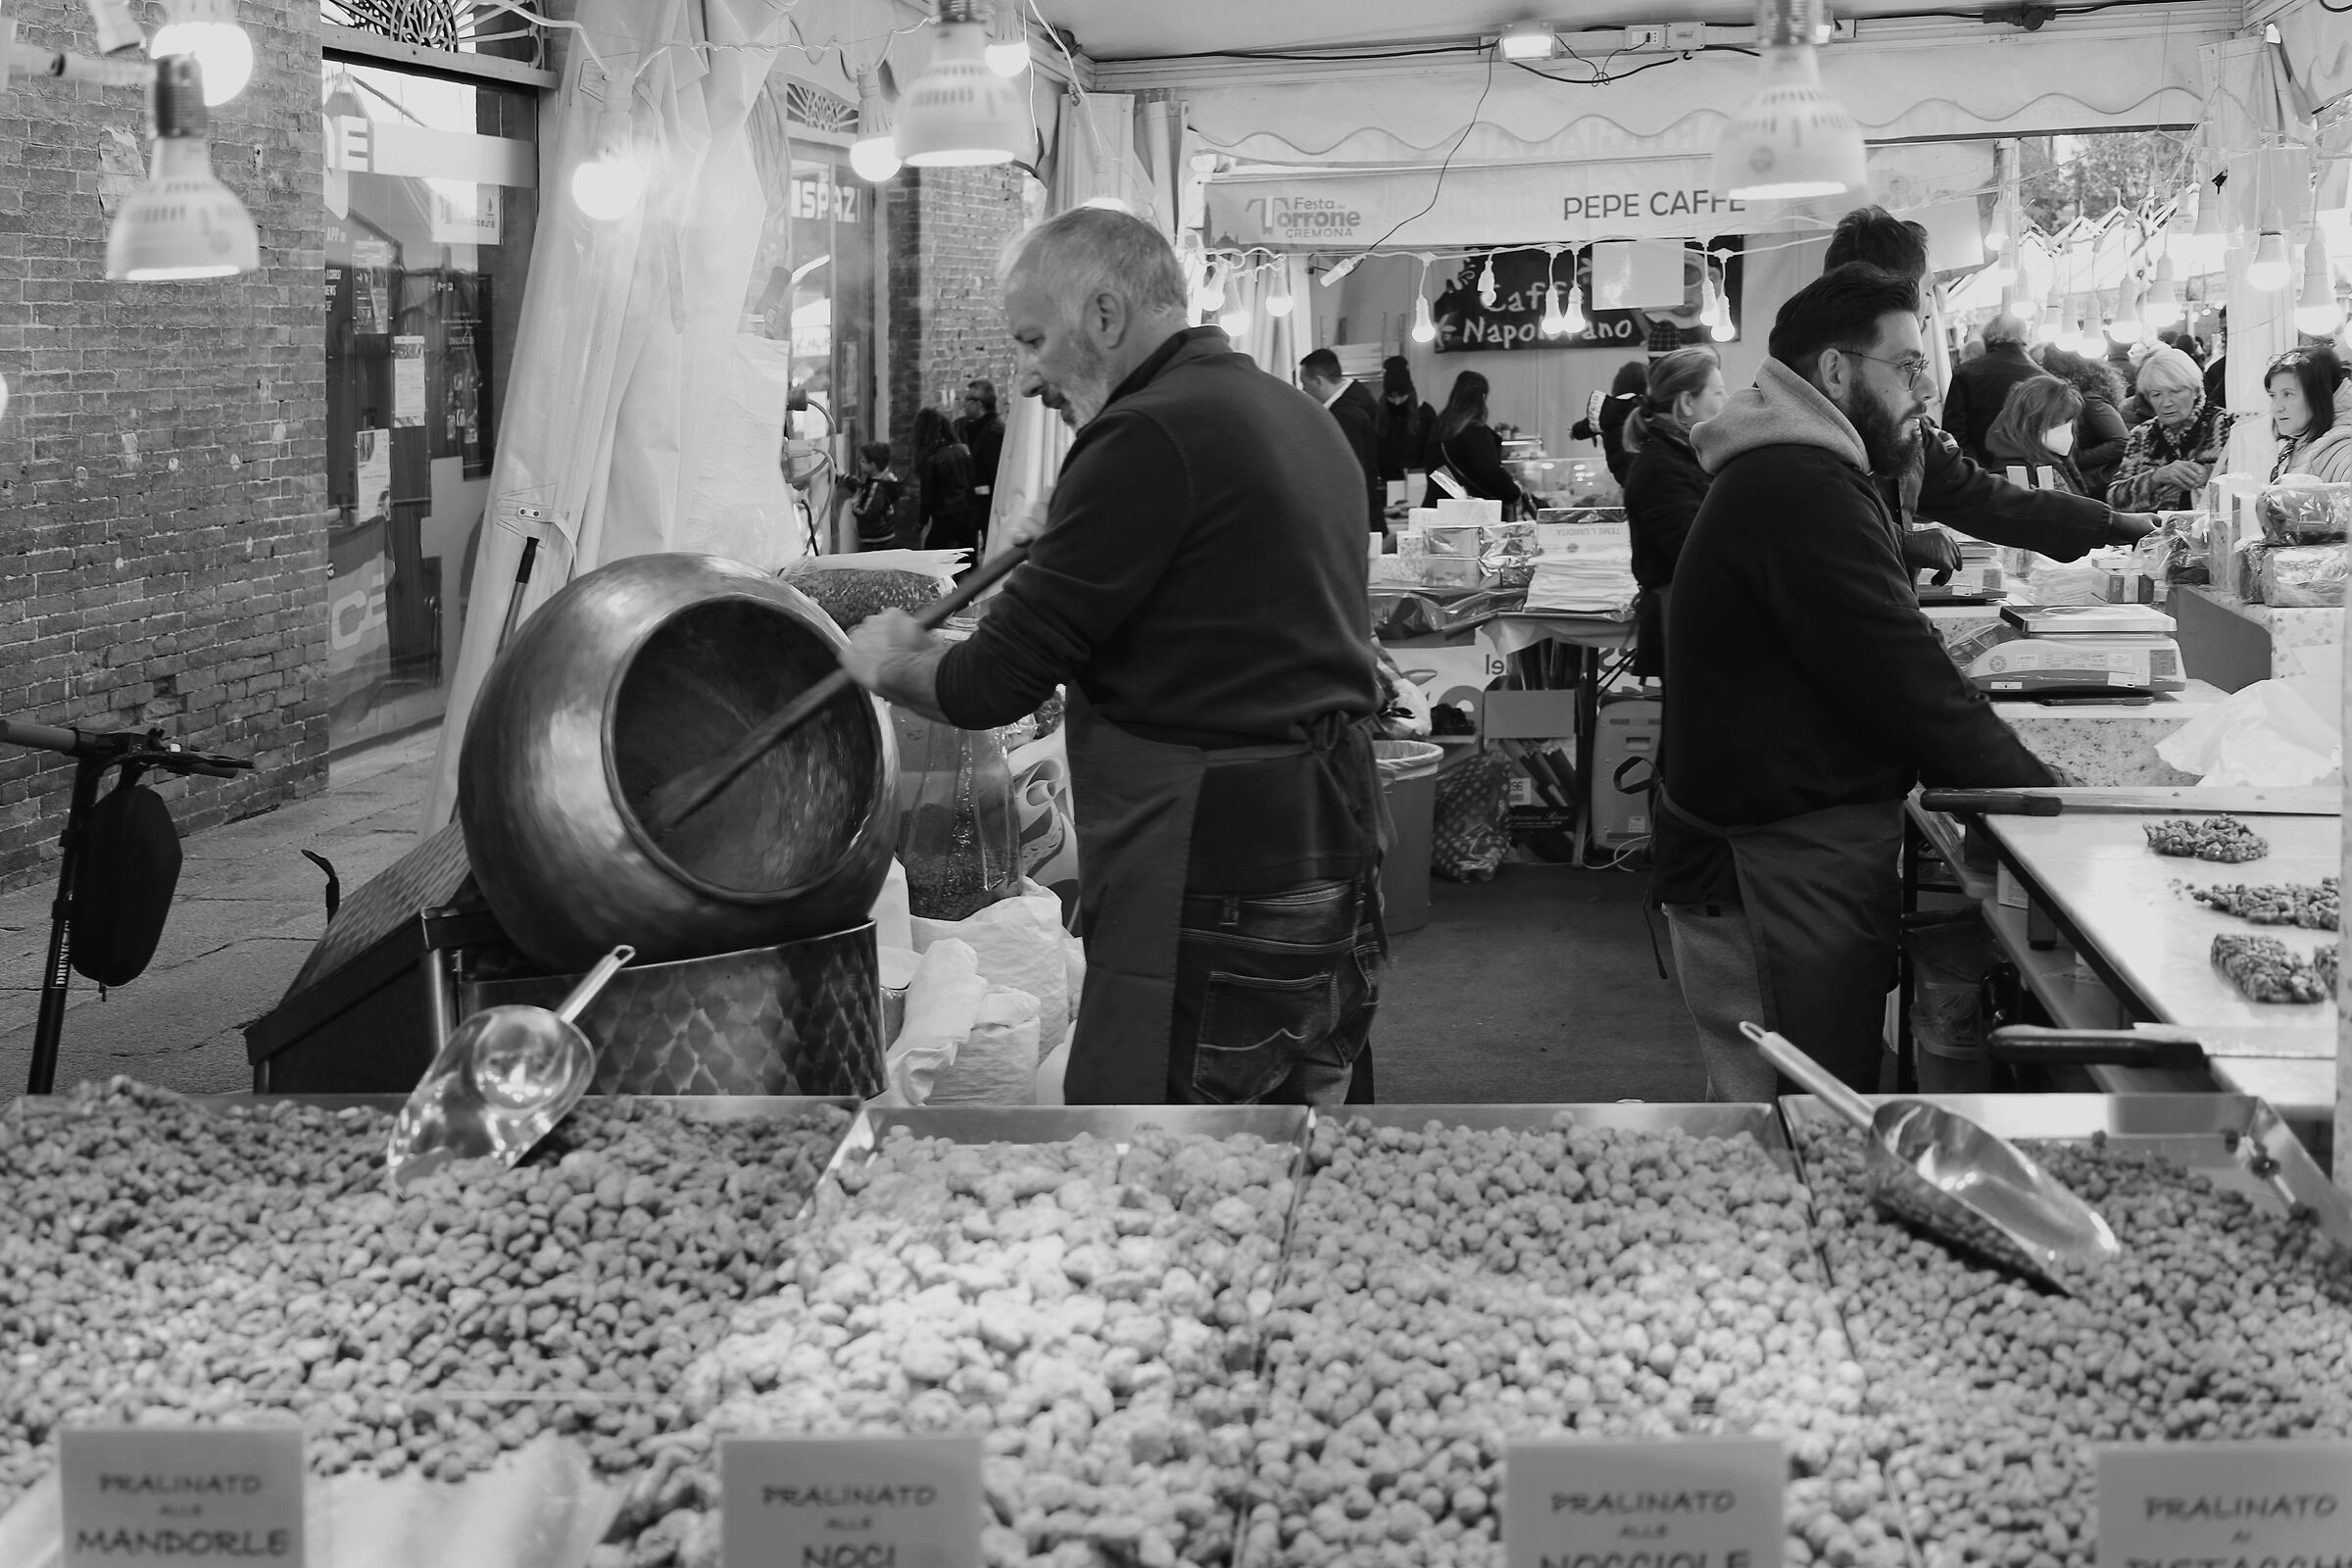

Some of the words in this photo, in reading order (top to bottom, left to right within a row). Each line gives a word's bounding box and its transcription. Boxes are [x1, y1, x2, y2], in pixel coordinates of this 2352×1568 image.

[1294, 197, 1335, 210] Festa
[1564, 193, 1640, 220] PEPE
[1285, 227, 1353, 238] CREMONA
[1462, 316, 1632, 349] Napolano
[99, 1473, 264, 1495] PRALINATO
[761, 1485, 937, 1508] PRALINATO
[1550, 1489, 1737, 1516] PRALINATO
[2145, 1494, 2339, 1521] PRALINATO
[74, 1526, 291, 1558] MANDORLE
[802, 1543, 897, 1568] NOCI
